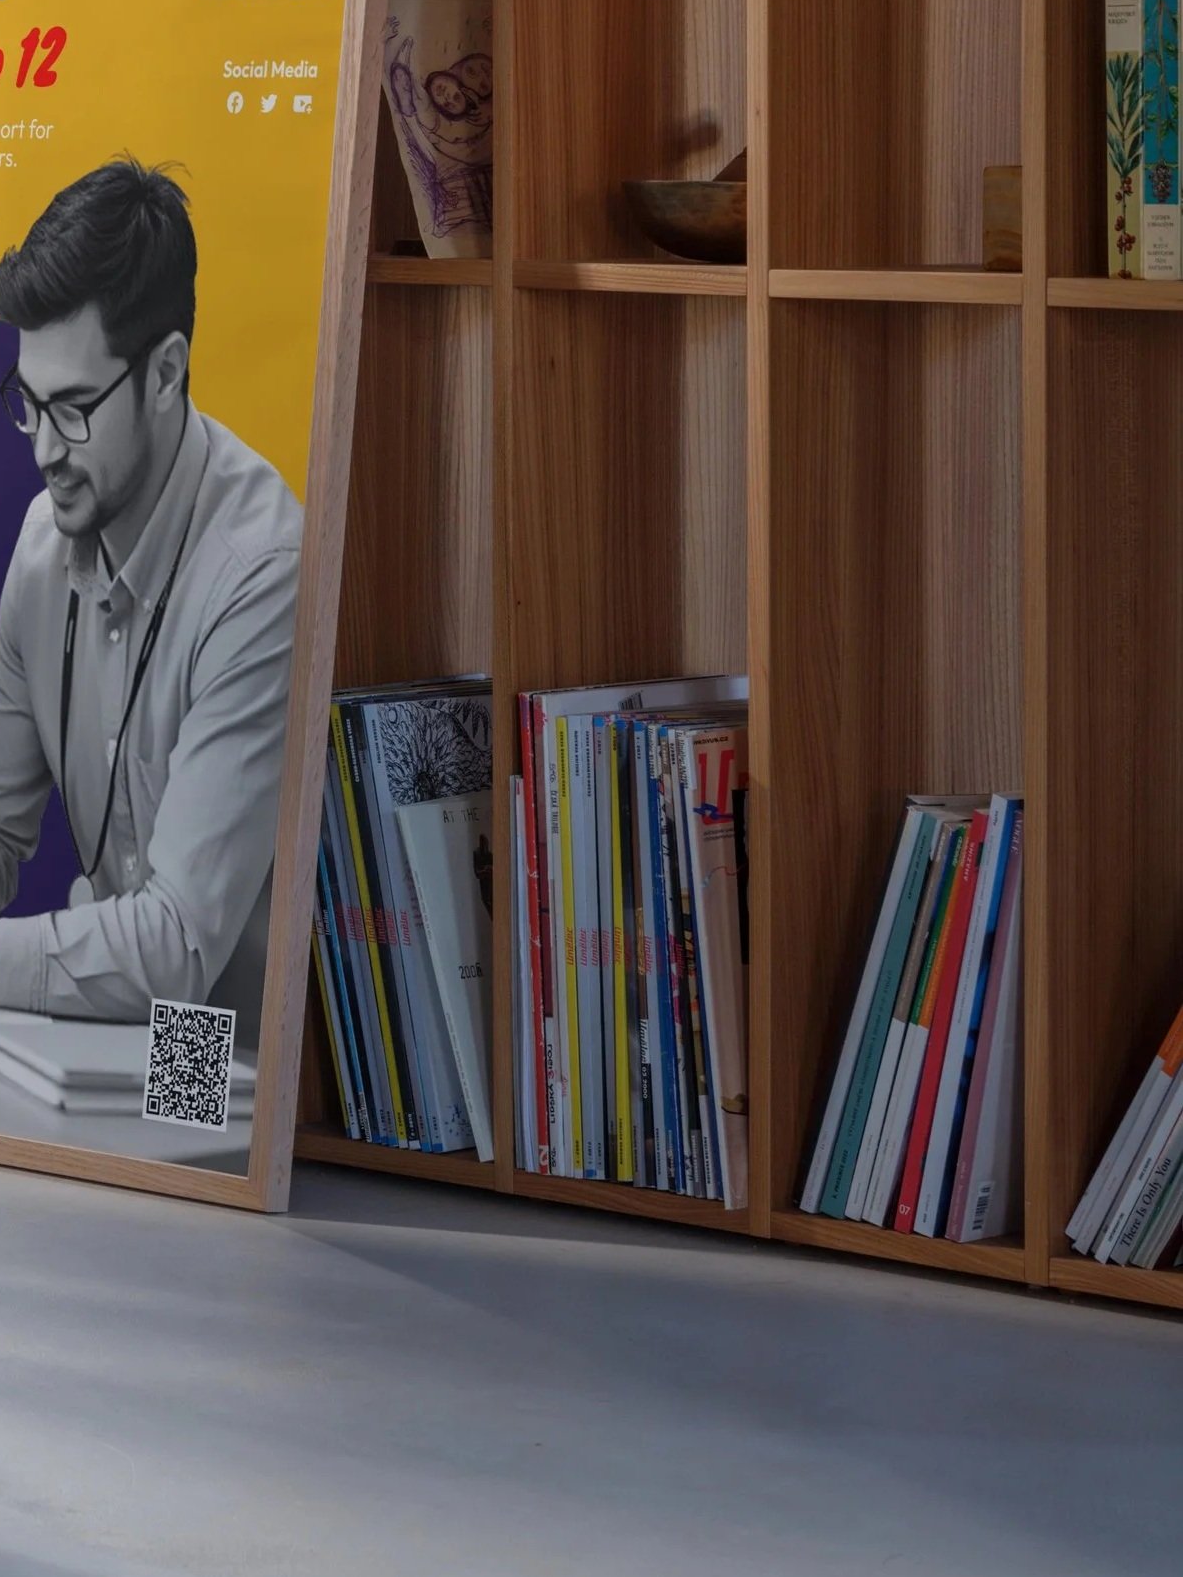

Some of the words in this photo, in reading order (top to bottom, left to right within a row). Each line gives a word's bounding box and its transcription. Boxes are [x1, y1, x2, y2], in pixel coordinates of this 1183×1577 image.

[16, 26, 67, 88] 12
[223, 60, 267, 80] Social
[270, 61, 318, 80] Media
[28, 119, 54, 139] for
[442, 810, 455, 823] AT
[463, 807, 480, 821] THE
[898, 1204, 910, 1215] 07
[1120, 1220, 1140, 1247] There
[1136, 1206, 1147, 1218] Is
[1143, 1182, 1162, 1206] Only
[1155, 1158, 1171, 1176] You
